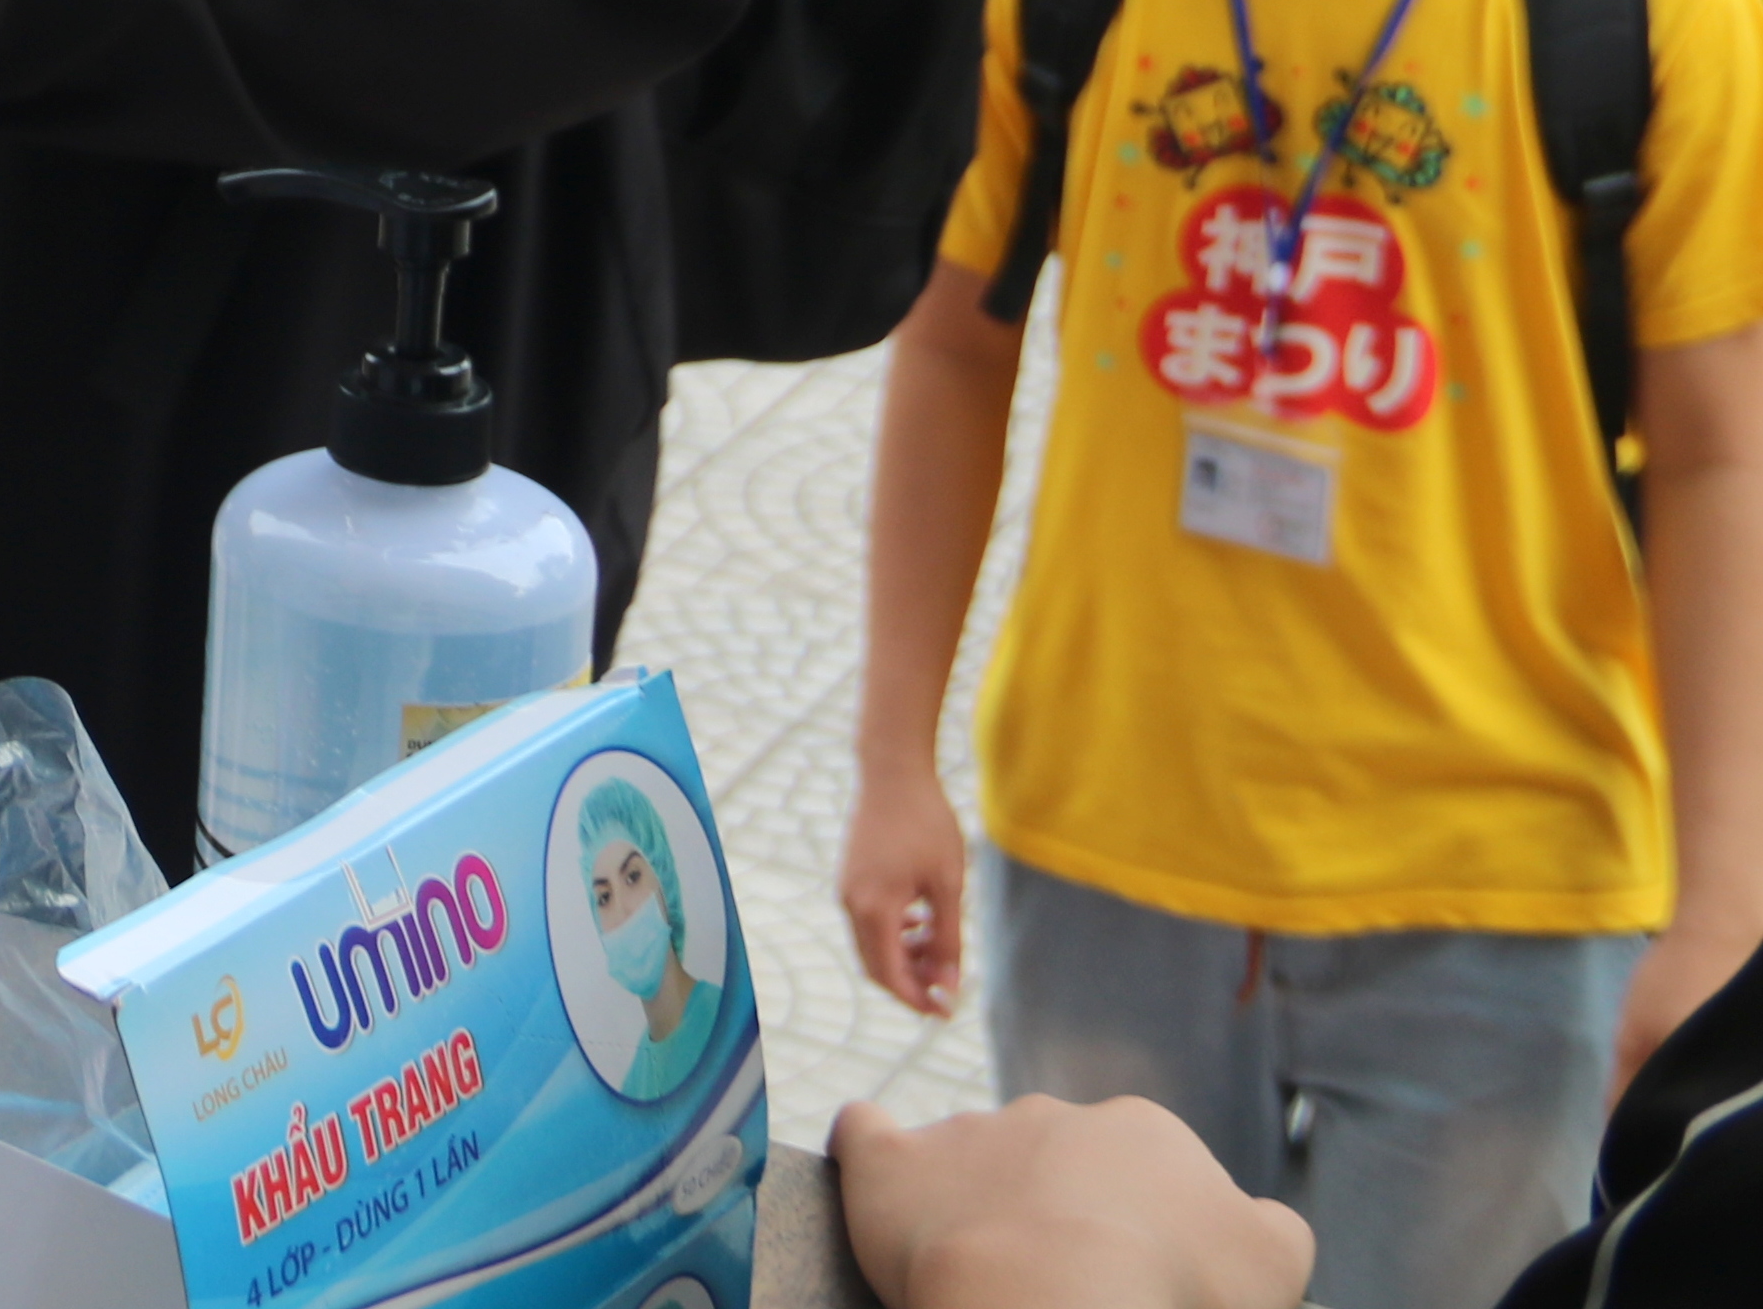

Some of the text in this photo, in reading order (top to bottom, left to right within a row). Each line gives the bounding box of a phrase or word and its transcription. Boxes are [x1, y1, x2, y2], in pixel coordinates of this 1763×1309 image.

[1196, 205, 1388, 303] 神戸
[1158, 303, 1420, 417] まつり
[192, 1077, 241, 1122] LONG
[232, 1027, 484, 1246] KHẨU TRANG
[247, 1277, 263, 1308] 4
[267, 1241, 316, 1298] LỚP
[334, 1178, 410, 1254] DÙNG
[414, 1168, 426, 1199] 1
